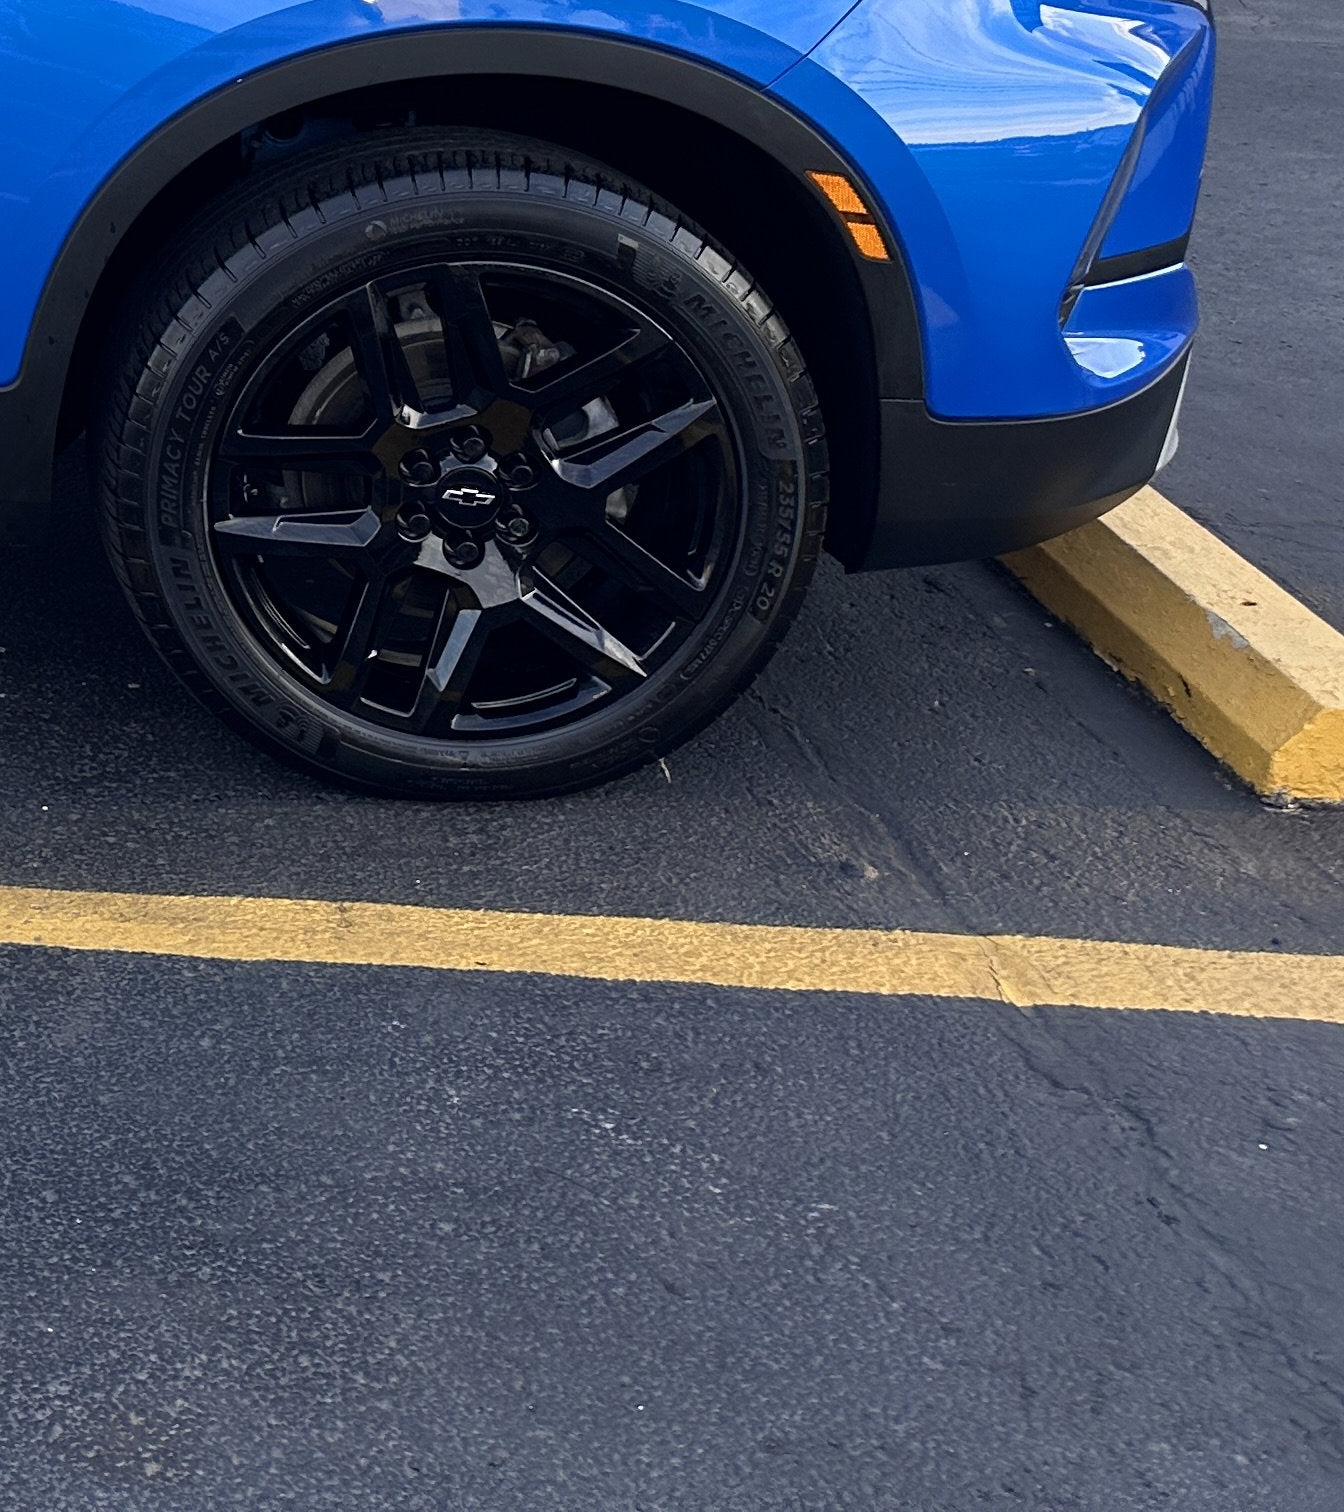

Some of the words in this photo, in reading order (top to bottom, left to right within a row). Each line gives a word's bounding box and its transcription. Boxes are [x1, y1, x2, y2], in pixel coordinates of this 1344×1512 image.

[683, 293, 785, 448] MICHELIN
[161, 427, 185, 528] PRIMACY
[176, 364, 212, 422] TOUR
[208, 332, 230, 362] A/S
[768, 561, 783, 578] R
[772, 480, 794, 558] 235/55
[170, 556, 274, 707] MICHELIN
[756, 582, 775, 611] 20
